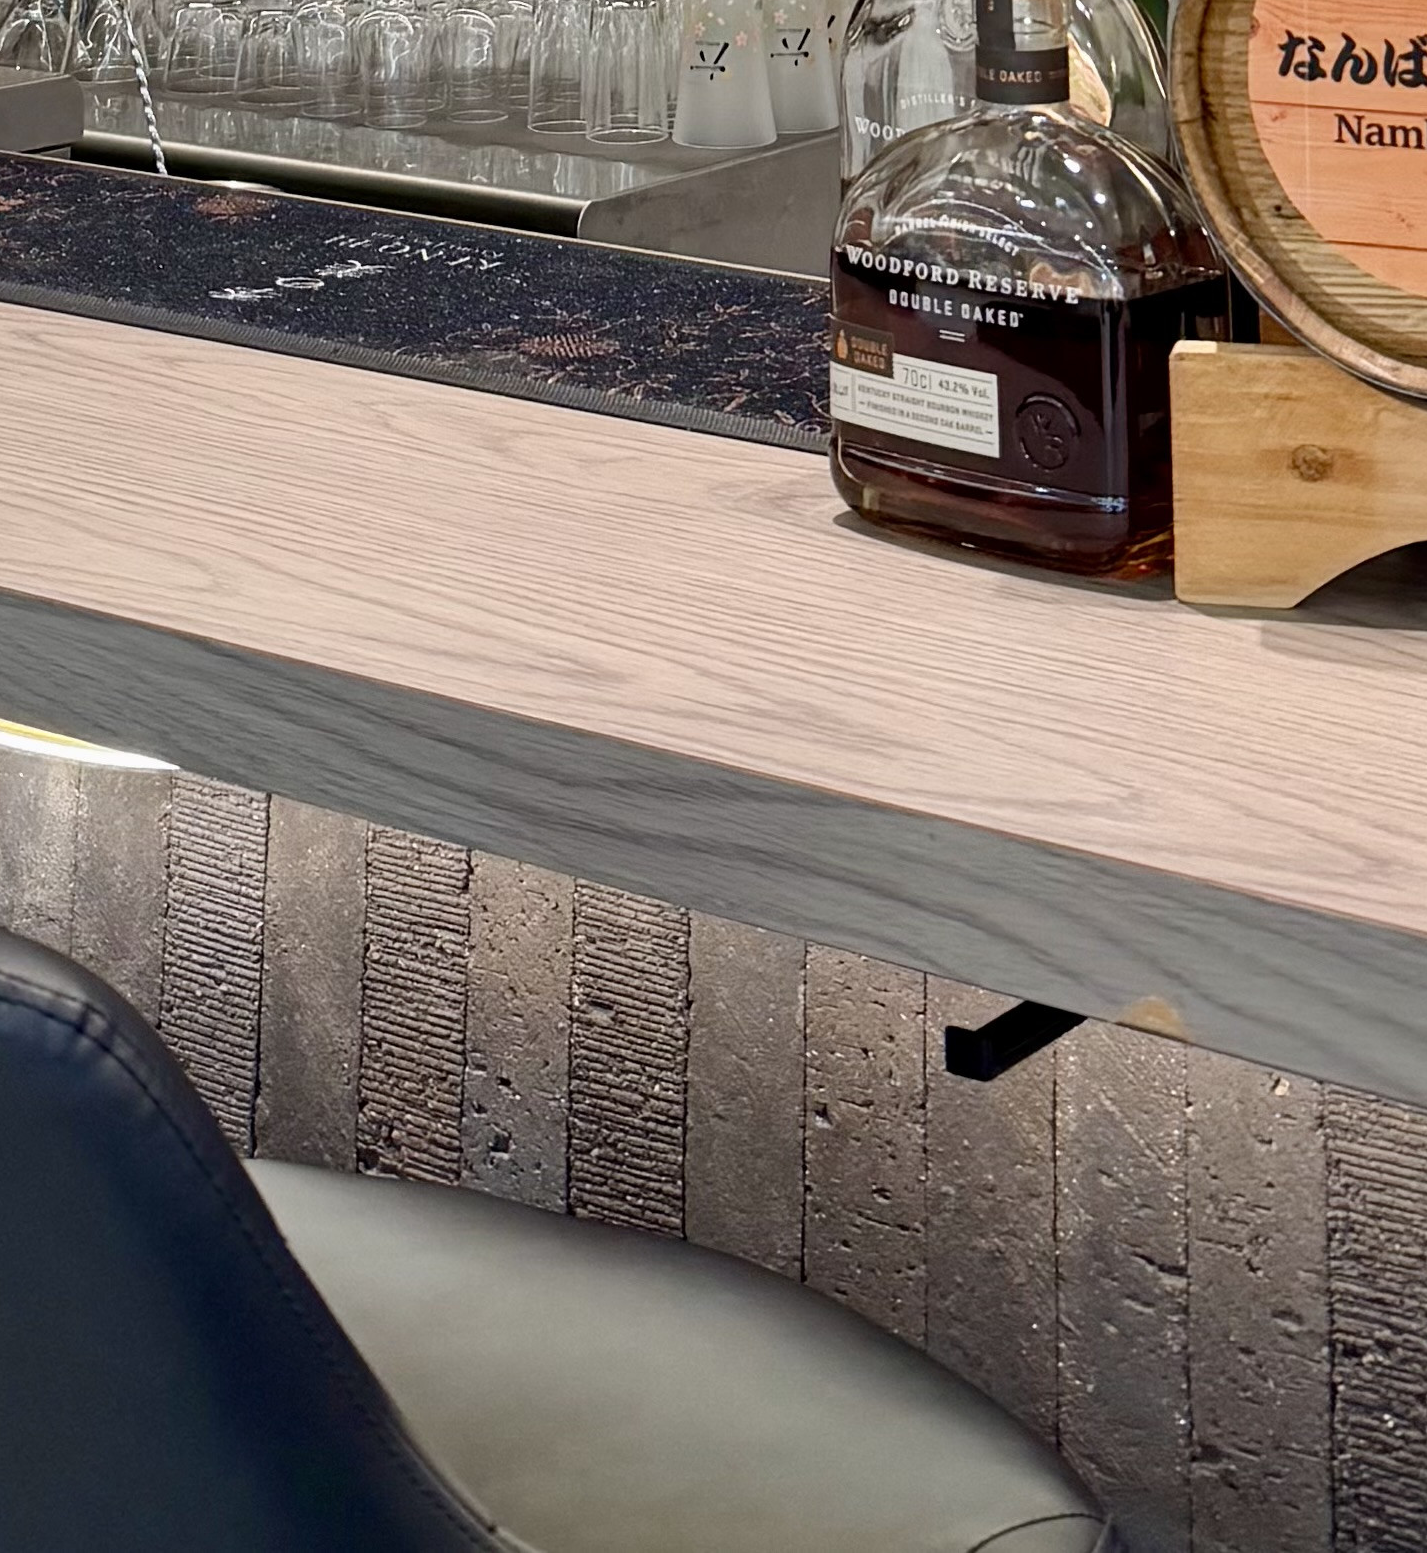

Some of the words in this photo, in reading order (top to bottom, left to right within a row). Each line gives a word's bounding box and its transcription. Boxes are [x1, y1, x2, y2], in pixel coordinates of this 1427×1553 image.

[999, 69, 1042, 84] OAKED
[977, 227, 1020, 257] SELECT
[846, 244, 960, 287] WOODFORD
[968, 268, 1084, 307] RESERVE
[888, 289, 953, 317] DOUBLE
[960, 306, 1020, 329] OAKED
[851, 335, 888, 356] DOUBLE
[852, 352, 887, 370] OAKED
[902, 365, 933, 390] 70cl
[938, 378, 969, 396] 43.2%
[857, 383, 891, 401] KENTUCKY
[891, 390, 925, 407] STRAIGHT
[926, 399, 960, 414] BOURBON
[960, 404, 995, 421] WHISKEY
[955, 419, 985, 436] BARREL
